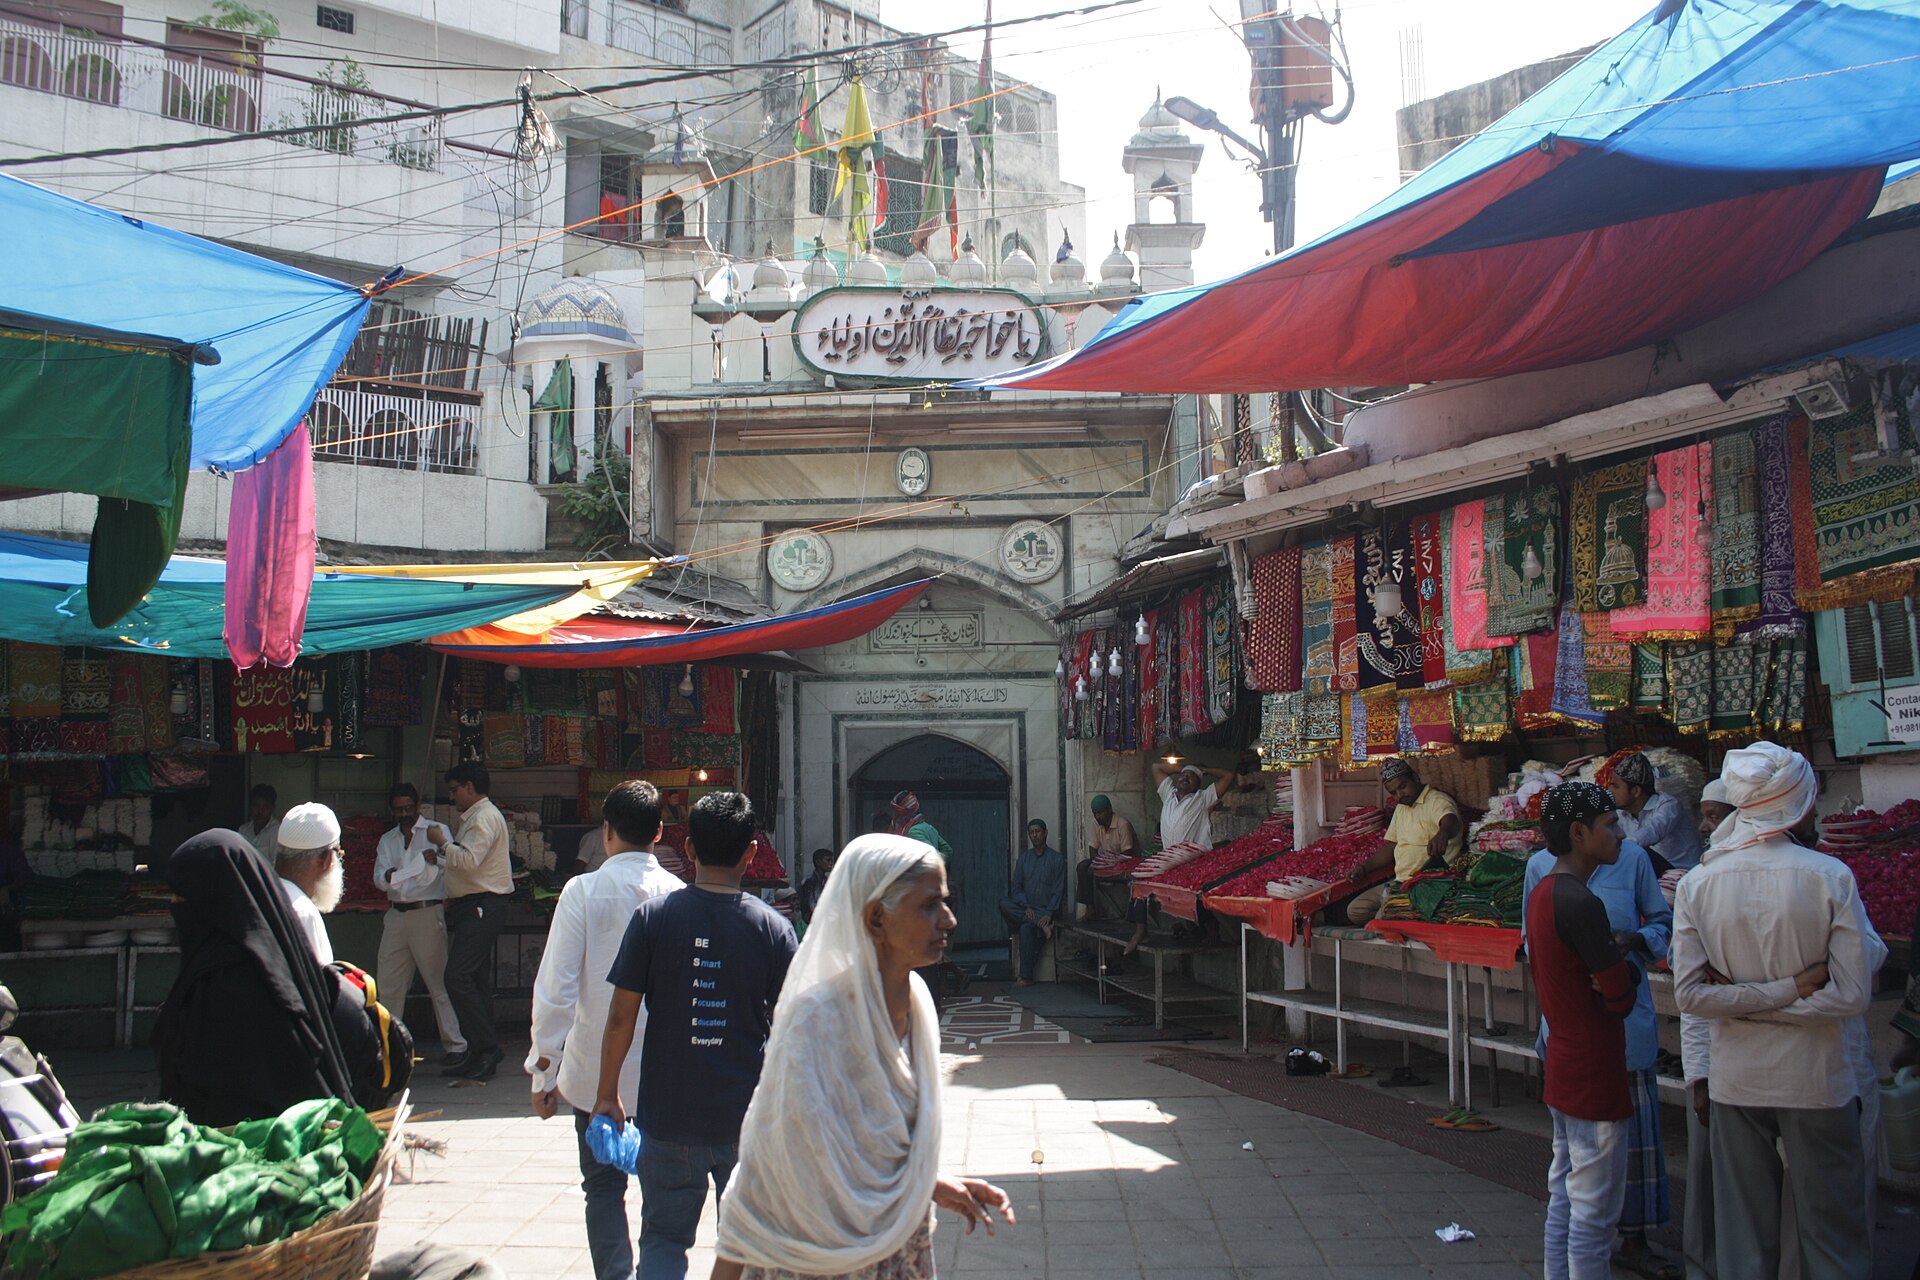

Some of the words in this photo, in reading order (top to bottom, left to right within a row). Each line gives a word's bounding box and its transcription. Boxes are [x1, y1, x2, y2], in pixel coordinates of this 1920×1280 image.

[1887, 695, 1920, 706] Conta
[694, 937, 709, 948] BE
[693, 957, 721, 968] Smart
[692, 978, 715, 989] Alert
[692, 997, 726, 1008] Focused
[691, 1017, 726, 1027] Educated
[691, 1036, 723, 1047] Everyday
